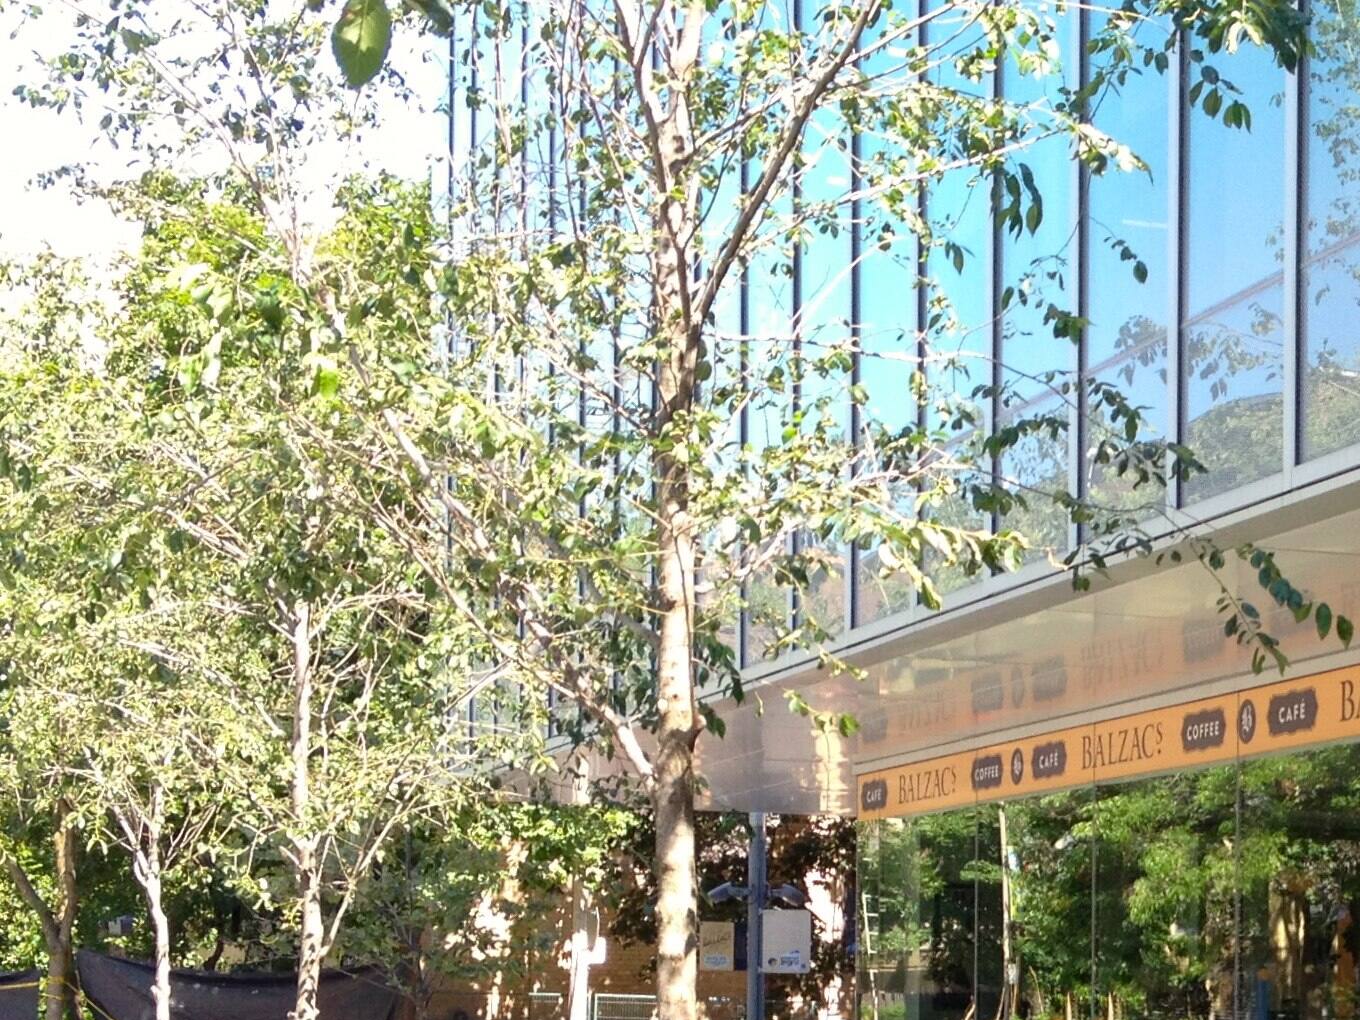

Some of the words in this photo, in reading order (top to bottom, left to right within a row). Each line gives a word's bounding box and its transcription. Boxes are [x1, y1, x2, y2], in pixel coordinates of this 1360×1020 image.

[975, 765, 999, 782] COFFEE
[1038, 754, 1059, 770] CAFÉ
[1186, 721, 1220, 741] COFFEE
[1278, 699, 1306, 723] CAFÉ
